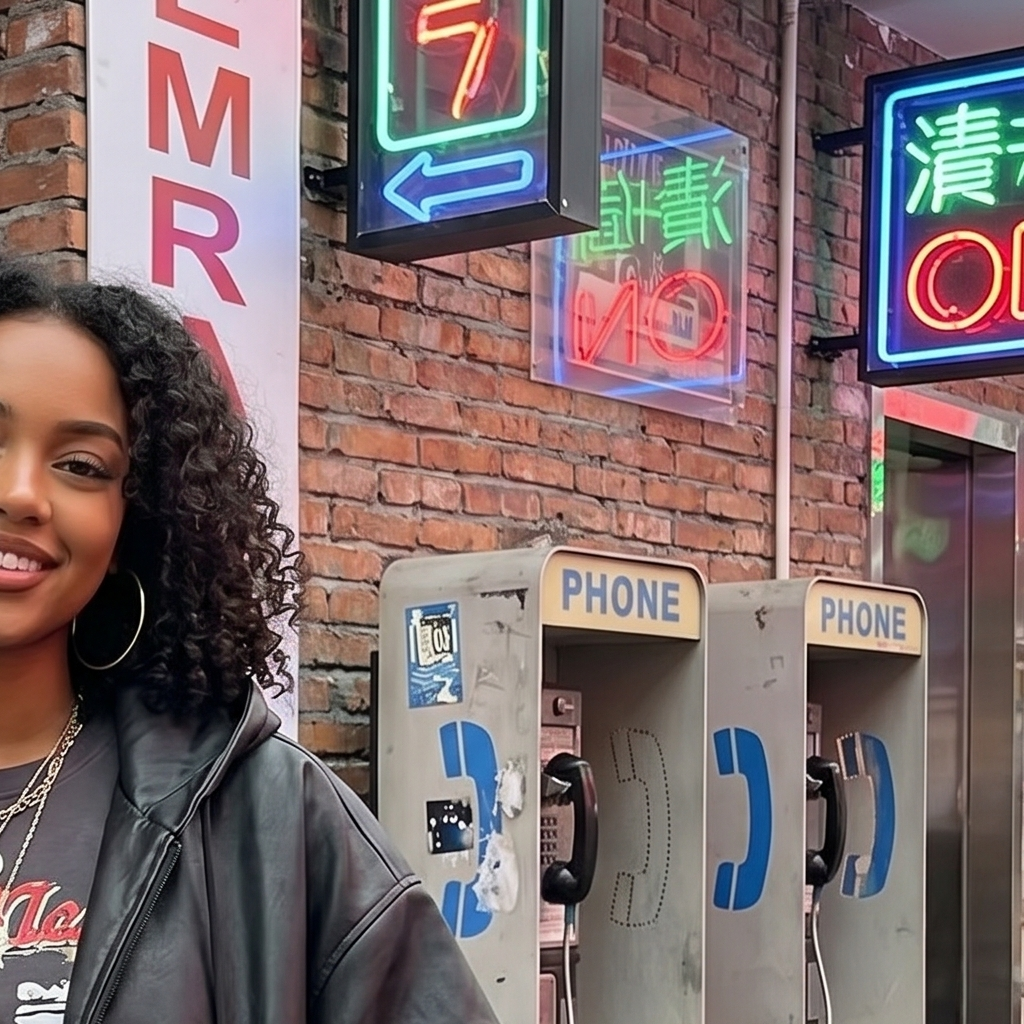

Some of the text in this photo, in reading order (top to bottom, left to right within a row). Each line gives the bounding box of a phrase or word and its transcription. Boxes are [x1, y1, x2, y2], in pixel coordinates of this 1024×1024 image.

[906, 229, 1024, 331] O
[562, 568, 680, 622] PHONE
[821, 596, 906, 640] PHONE
